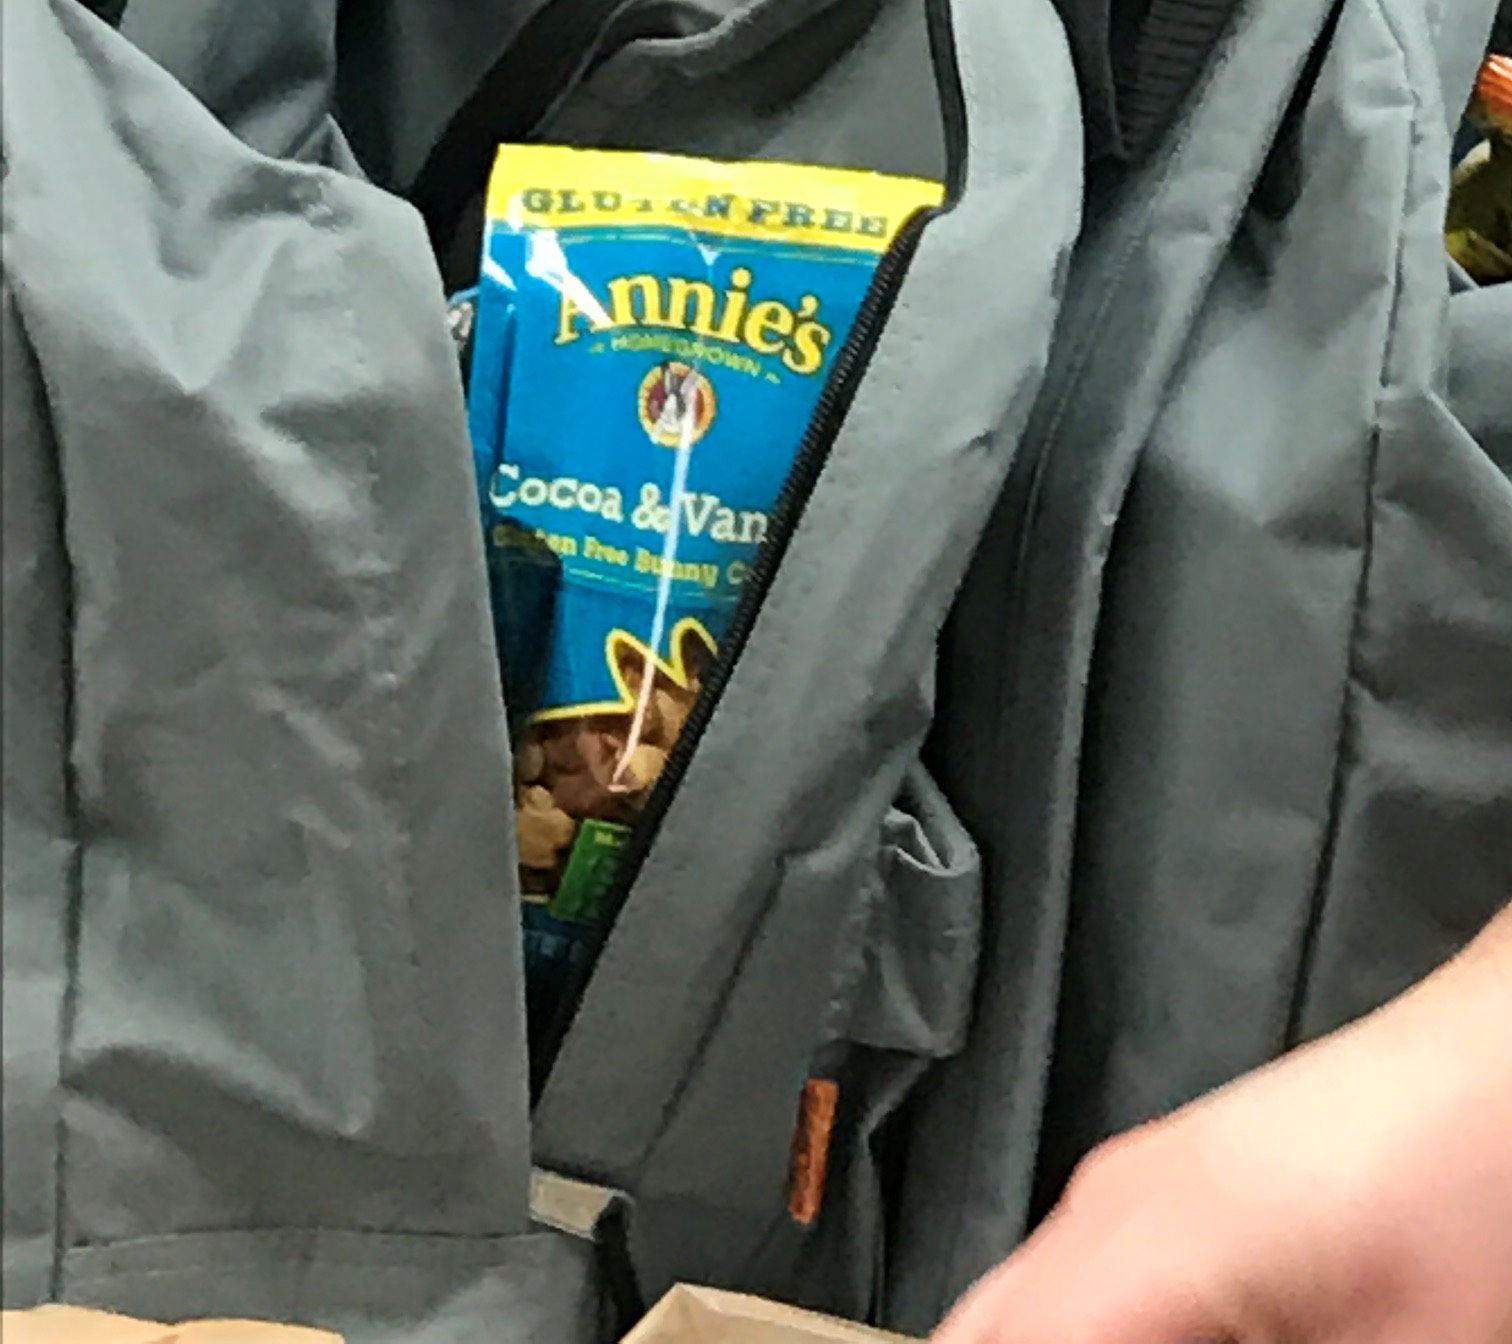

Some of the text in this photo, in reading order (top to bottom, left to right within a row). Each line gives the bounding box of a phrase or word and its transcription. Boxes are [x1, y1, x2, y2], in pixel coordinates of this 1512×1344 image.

[746, 198, 889, 238] FREE
[554, 266, 832, 375] Annie's
[488, 462, 626, 524] Cocoa
[630, 482, 672, 534] &
[583, 535, 629, 567] Free
